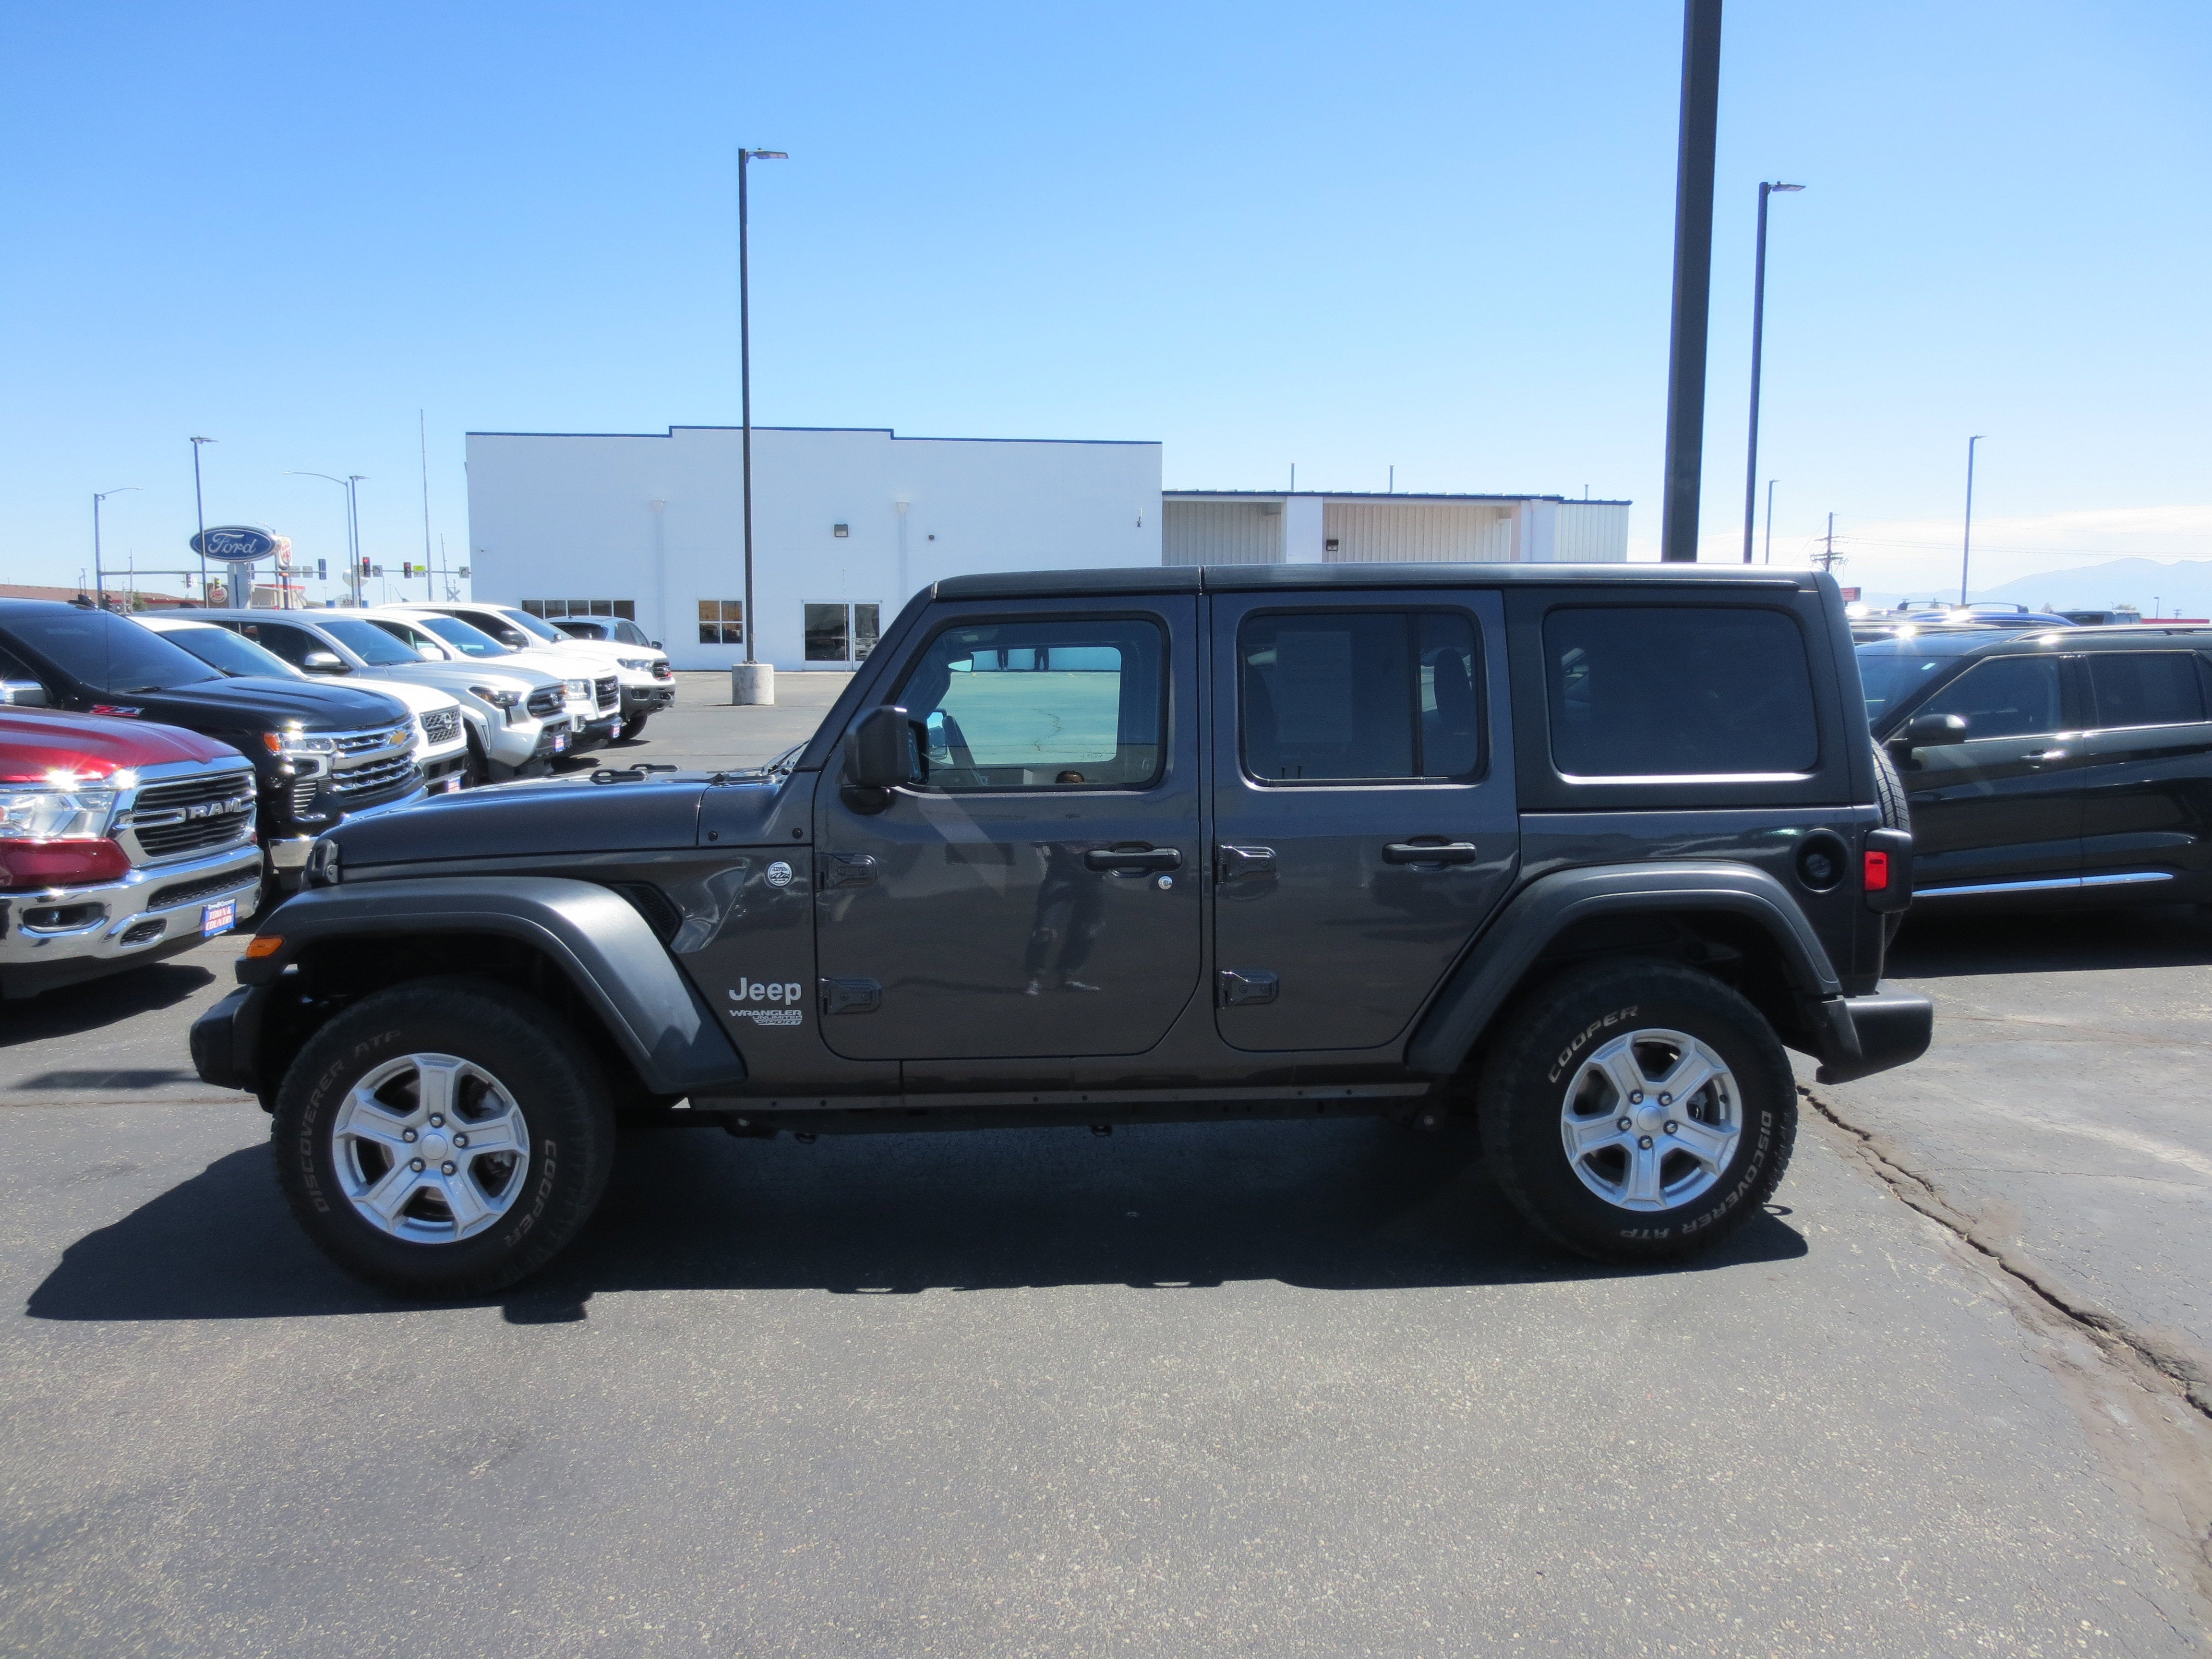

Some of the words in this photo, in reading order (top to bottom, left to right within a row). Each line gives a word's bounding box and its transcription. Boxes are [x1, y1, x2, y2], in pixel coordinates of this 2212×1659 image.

[207, 533, 257, 553] Ford
[189, 797, 241, 819] RAM
[205, 914, 234, 931] COUNTRY
[729, 977, 802, 1005] Jeep
[1549, 1006, 1638, 1083] COOPER
[300, 1059, 345, 1213] DISCOVERER
[504, 1140, 557, 1248] COOPER
[1682, 1110, 1772, 1234] DISCOVERER
